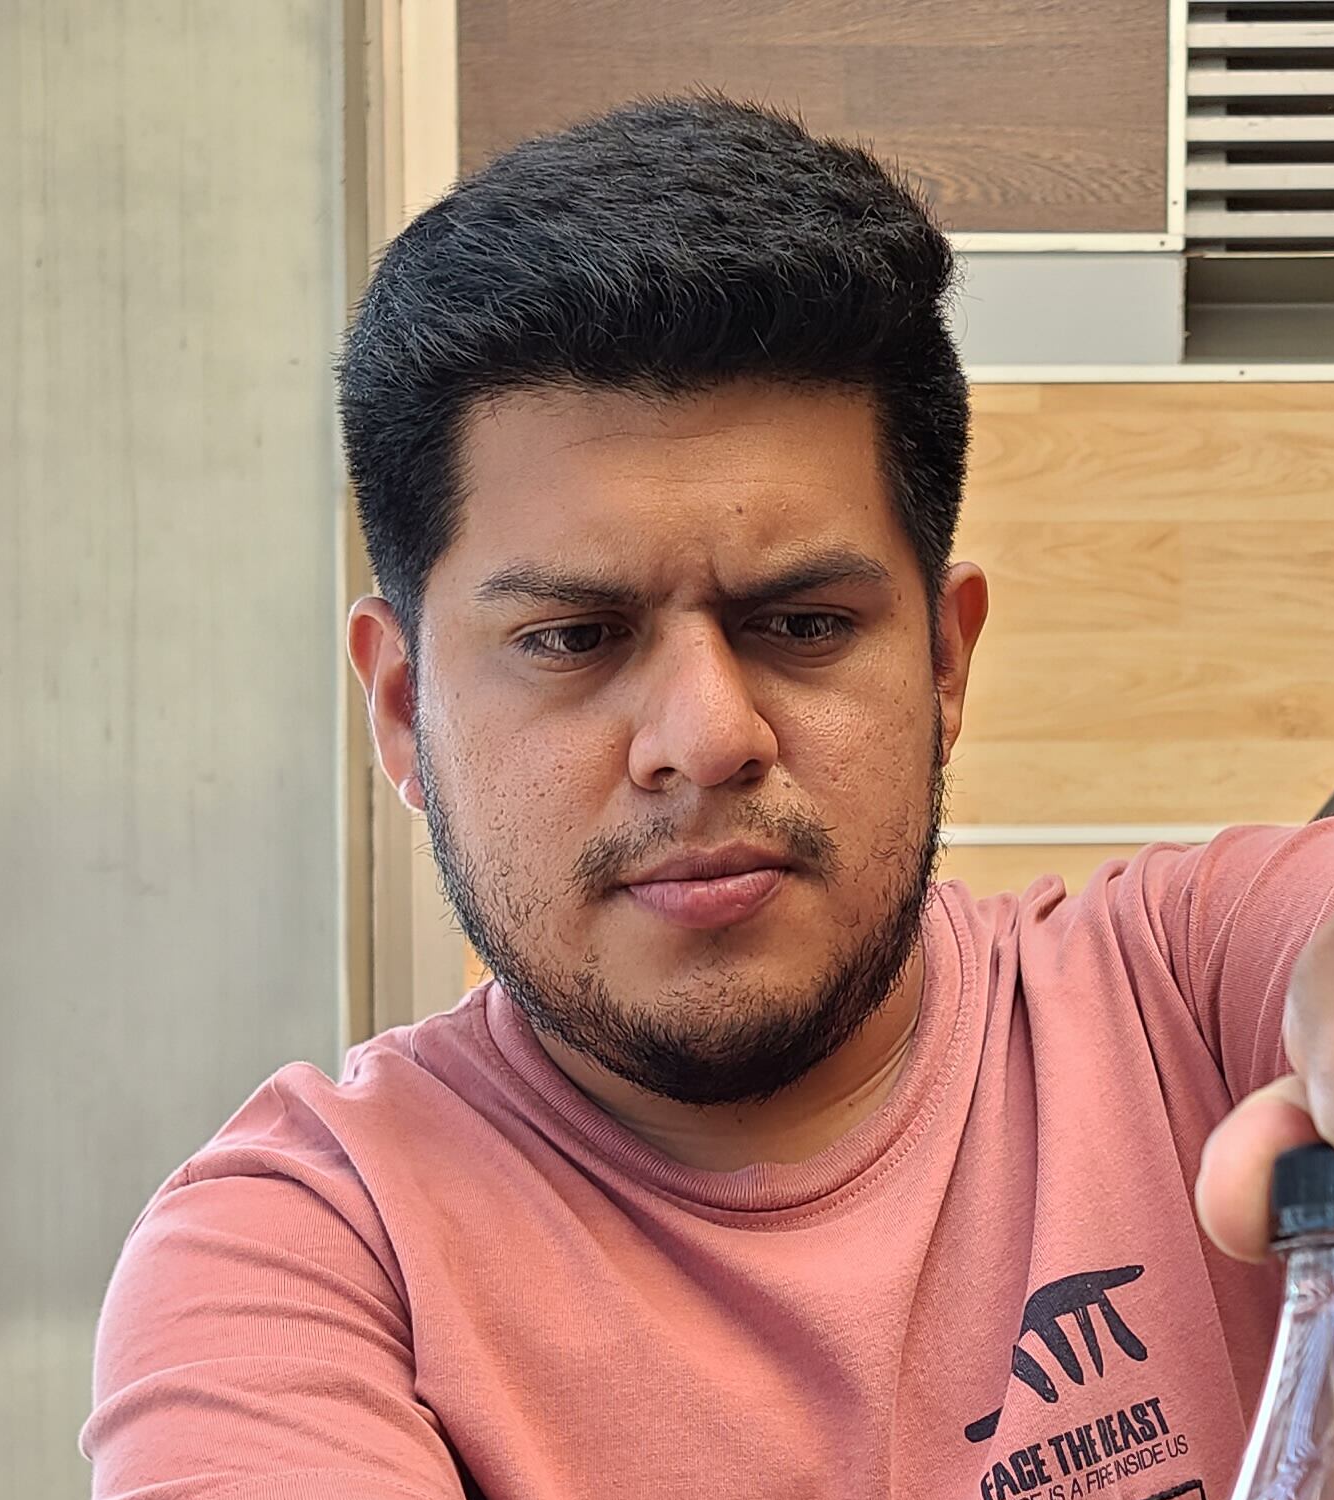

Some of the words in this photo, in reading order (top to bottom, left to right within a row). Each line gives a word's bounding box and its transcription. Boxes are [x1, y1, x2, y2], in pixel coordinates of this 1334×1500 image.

[1047, 1423, 1101, 1477] THE
[1070, 1478, 1084, 1500] A
[1166, 1434, 1189, 1458] US
